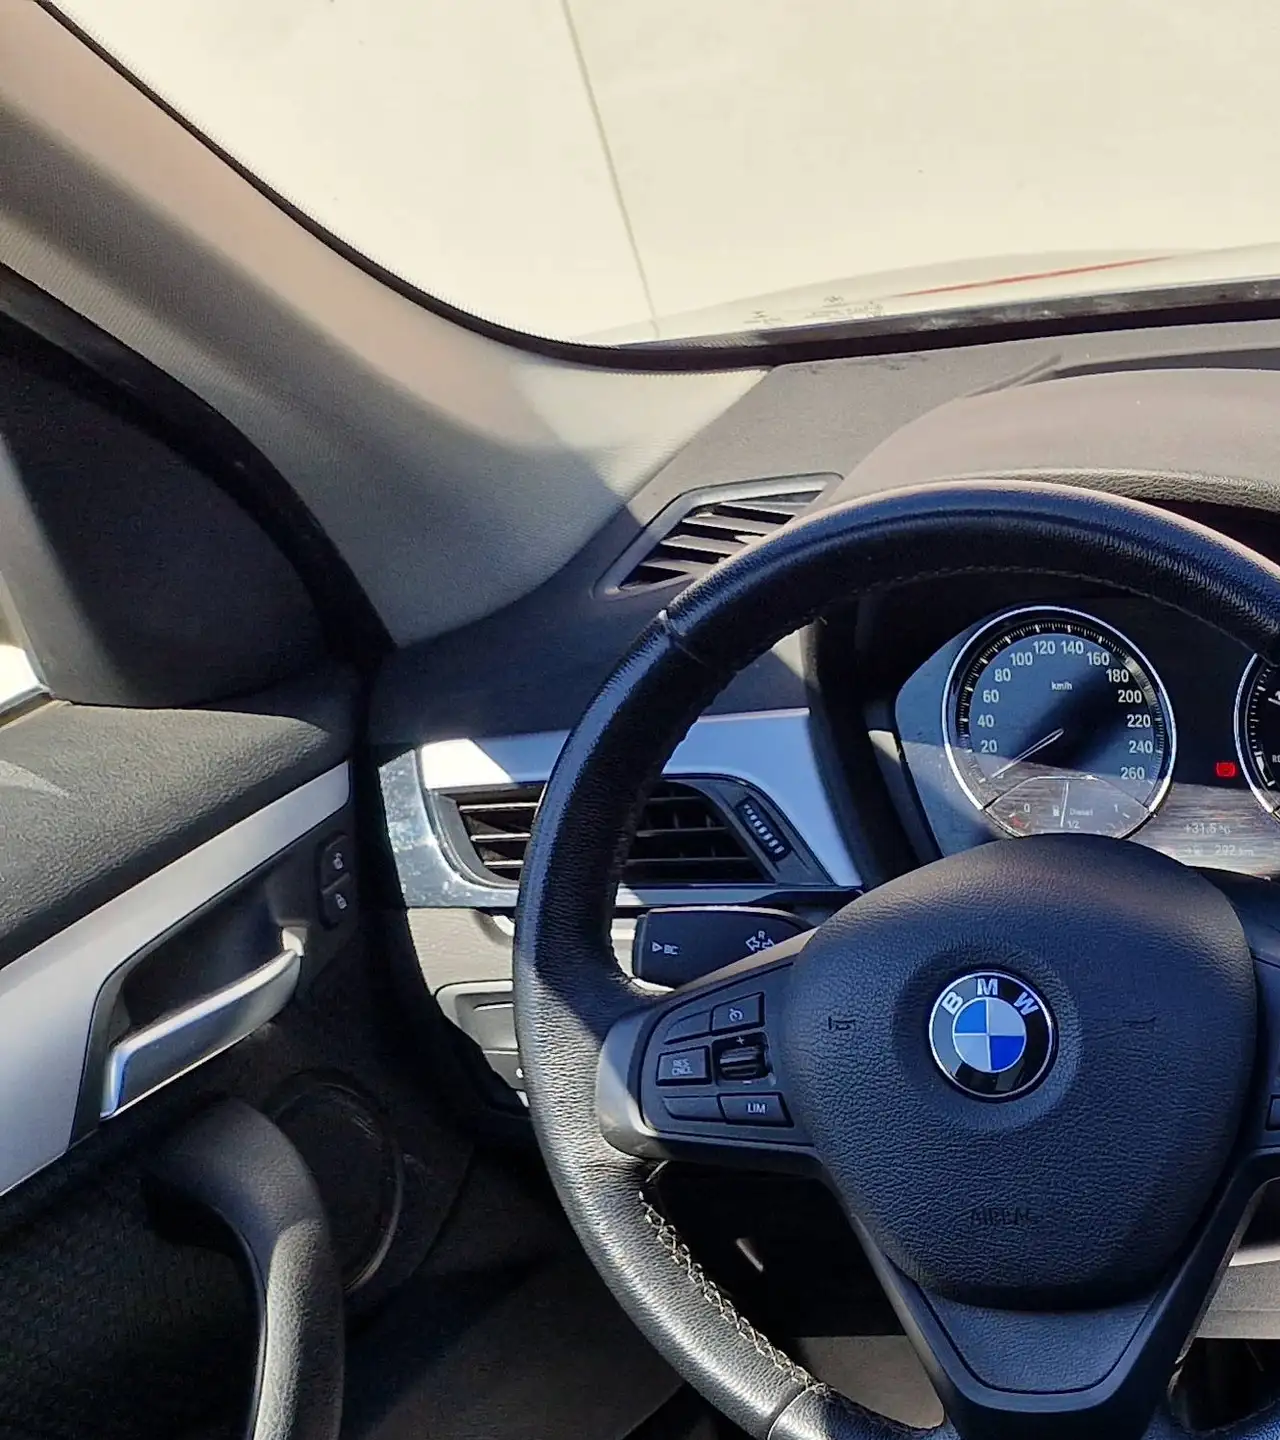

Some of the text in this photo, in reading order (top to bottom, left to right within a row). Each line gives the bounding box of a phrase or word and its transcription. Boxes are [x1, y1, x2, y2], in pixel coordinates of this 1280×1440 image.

[1033, 640, 1056, 655] 120
[1061, 640, 1084, 654] 140
[1010, 652, 1033, 666] 100
[1087, 652, 1110, 666] 160
[994, 668, 1012, 682] 80
[1106, 669, 1129, 683] 180
[1051, 681, 1073, 691] km/h
[983, 690, 1000, 704] 60
[1118, 689, 1143, 703] 200
[977, 714, 994, 728] 40
[1127, 714, 1151, 728] 220
[980, 740, 998, 753] 20
[1129, 740, 1154, 754] 240
[1120, 766, 1145, 780] 260
[941, 978, 1039, 1015] BMW
[747, 1102, 766, 1114] LIM
